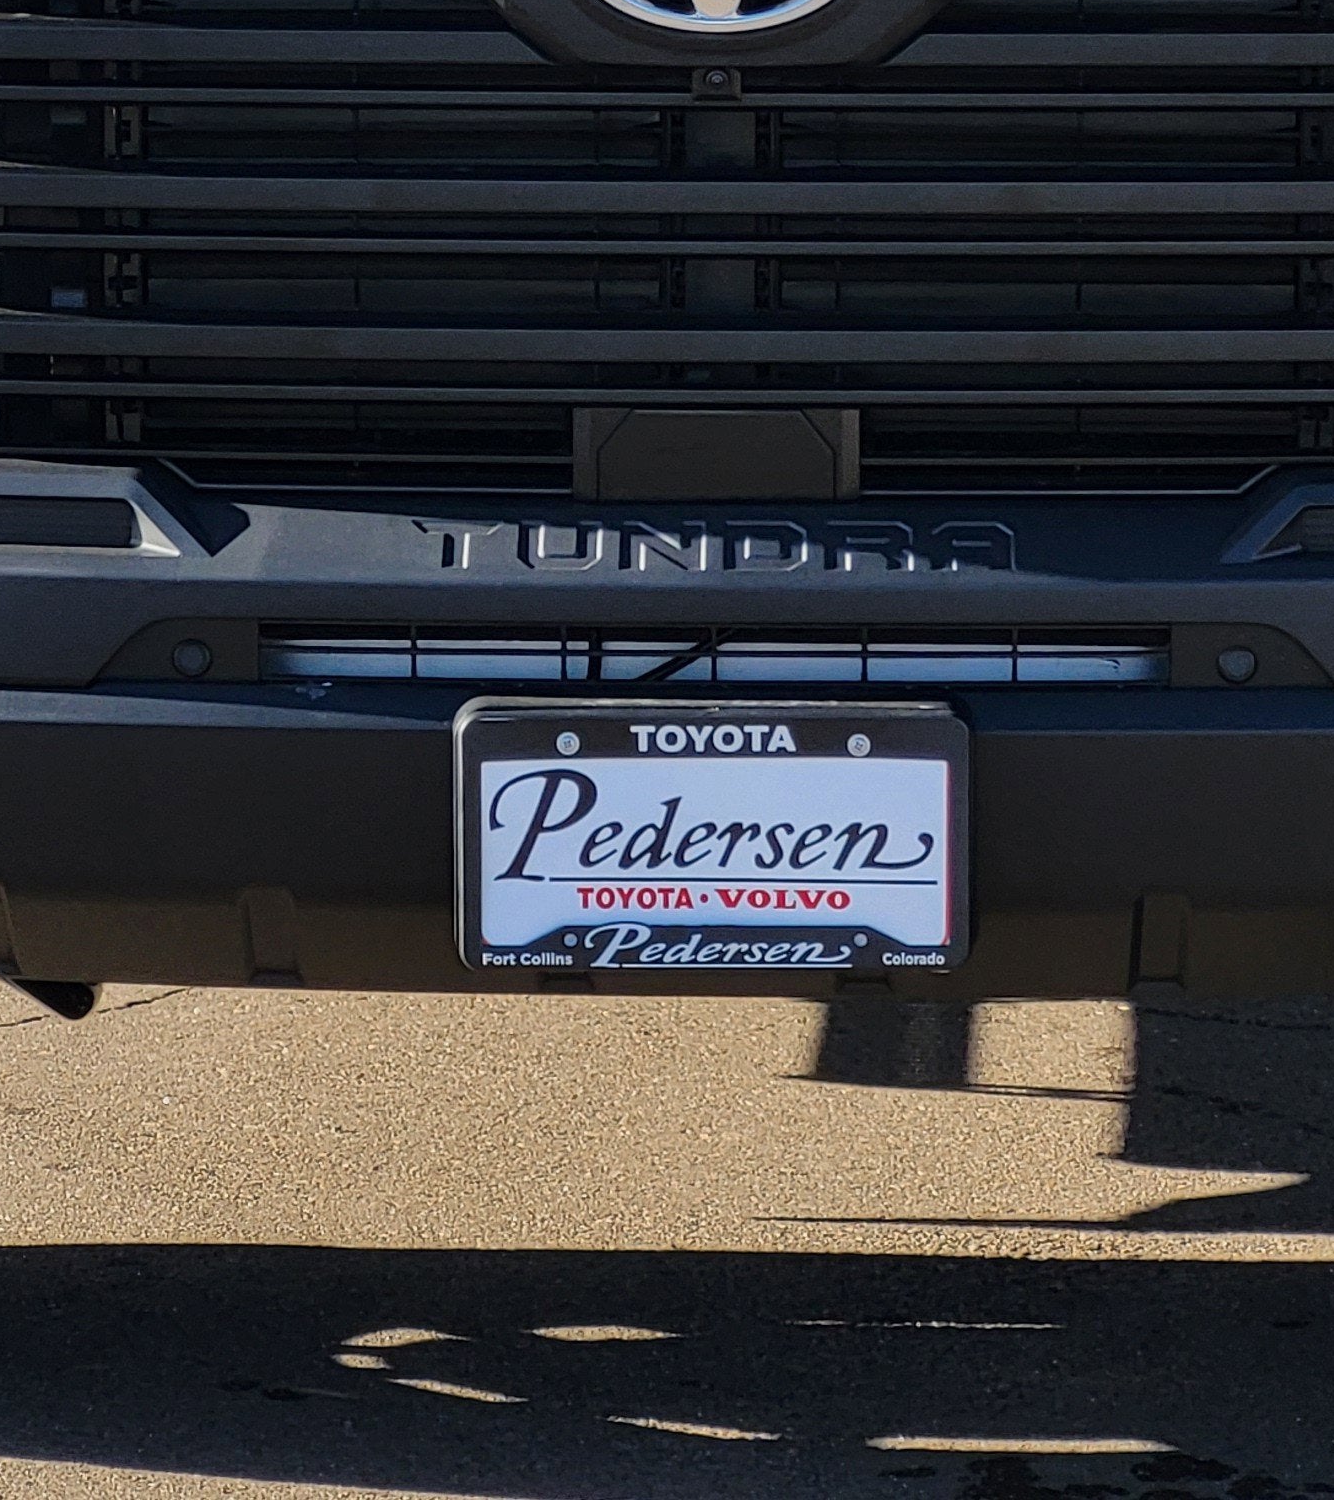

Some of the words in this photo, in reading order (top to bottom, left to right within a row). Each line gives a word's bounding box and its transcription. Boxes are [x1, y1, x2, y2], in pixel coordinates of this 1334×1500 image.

[412, 519, 1017, 571] TUNDRA
[630, 725, 797, 753] TOYOTA
[488, 768, 934, 882] Pedersen
[576, 887, 694, 910] TOYOTA
[714, 888, 851, 910] VOLVO
[482, 952, 516, 967] Fort
[520, 952, 573, 967] Collins
[584, 922, 852, 969] Pedersen
[881, 952, 946, 967] Colorado
